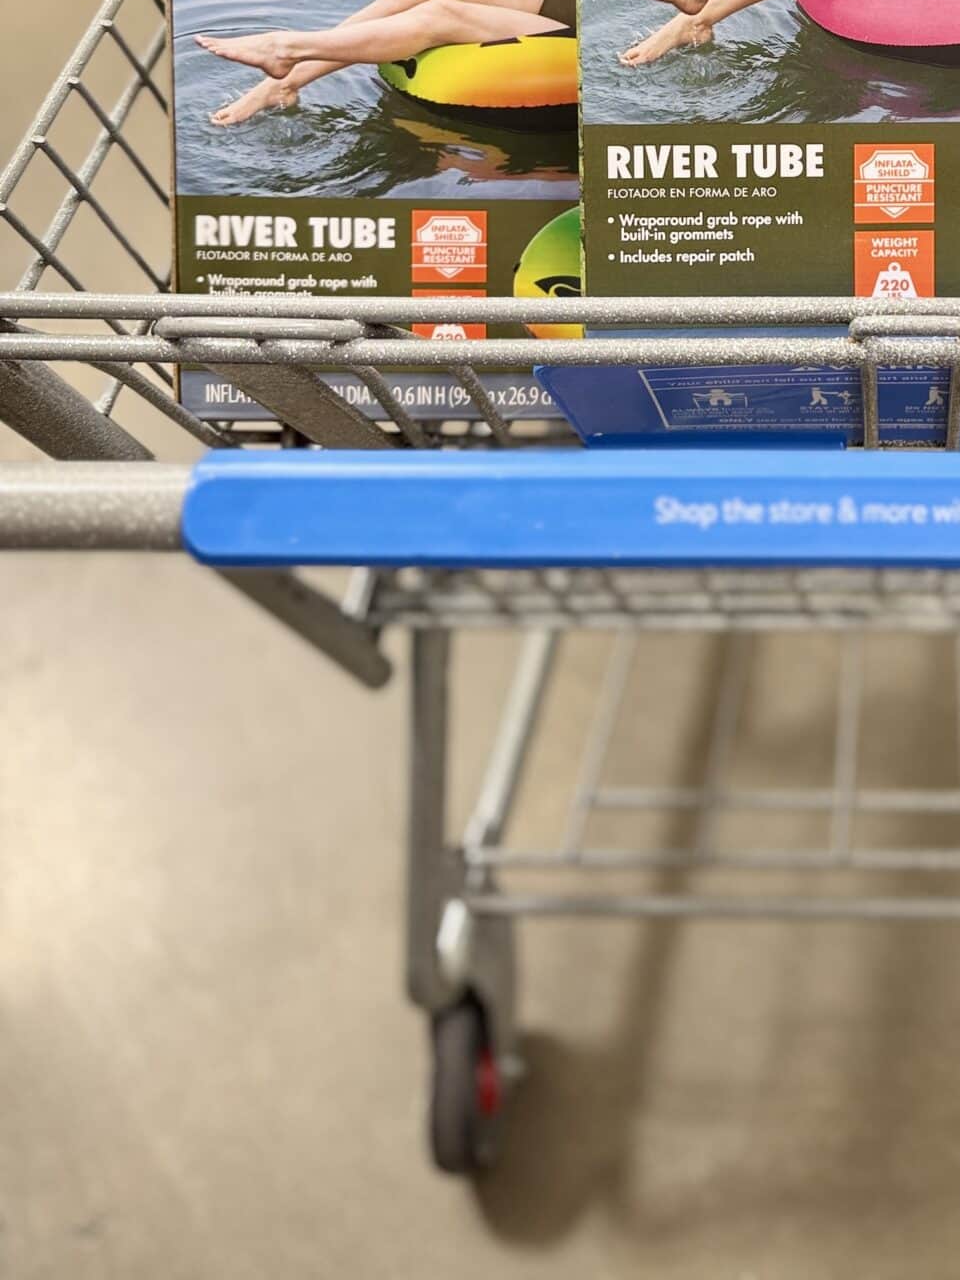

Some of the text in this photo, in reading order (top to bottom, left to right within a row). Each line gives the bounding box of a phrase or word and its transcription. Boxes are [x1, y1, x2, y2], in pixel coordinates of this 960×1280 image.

[606, 143, 824, 180] RIVER TUBE
[607, 186, 777, 199] FLOTADOR EN FORMA DE ARO
[866, 183, 923, 193] PUNCTURE
[866, 193, 923, 202] RESISTANT
[619, 211, 804, 229] Wraparound grab rope with
[194, 215, 397, 249] RIVER TUBE
[620, 228, 734, 245] built-in grommets
[871, 237, 919, 248] WEIGHT
[196, 250, 353, 263] FLOTADOR EN FORMA DE ARO
[423, 246, 476, 256] PUNCTURE
[620, 248, 755, 266] Includes repair patch
[871, 248, 919, 258] CAPACITY
[423, 256, 476, 264] RESISTANT
[207, 273, 378, 292] Wraparound grab rope with
[879, 279, 910, 292] 220
[417, 387, 431, 405] IN
[435, 387, 446, 405] H
[509, 386, 537, 405] 26.9
[654, 496, 718, 532] Shop
[722, 497, 764, 524] the
[768, 498, 833, 524] store
[838, 496, 857, 524] &
[862, 503, 928, 524] more
